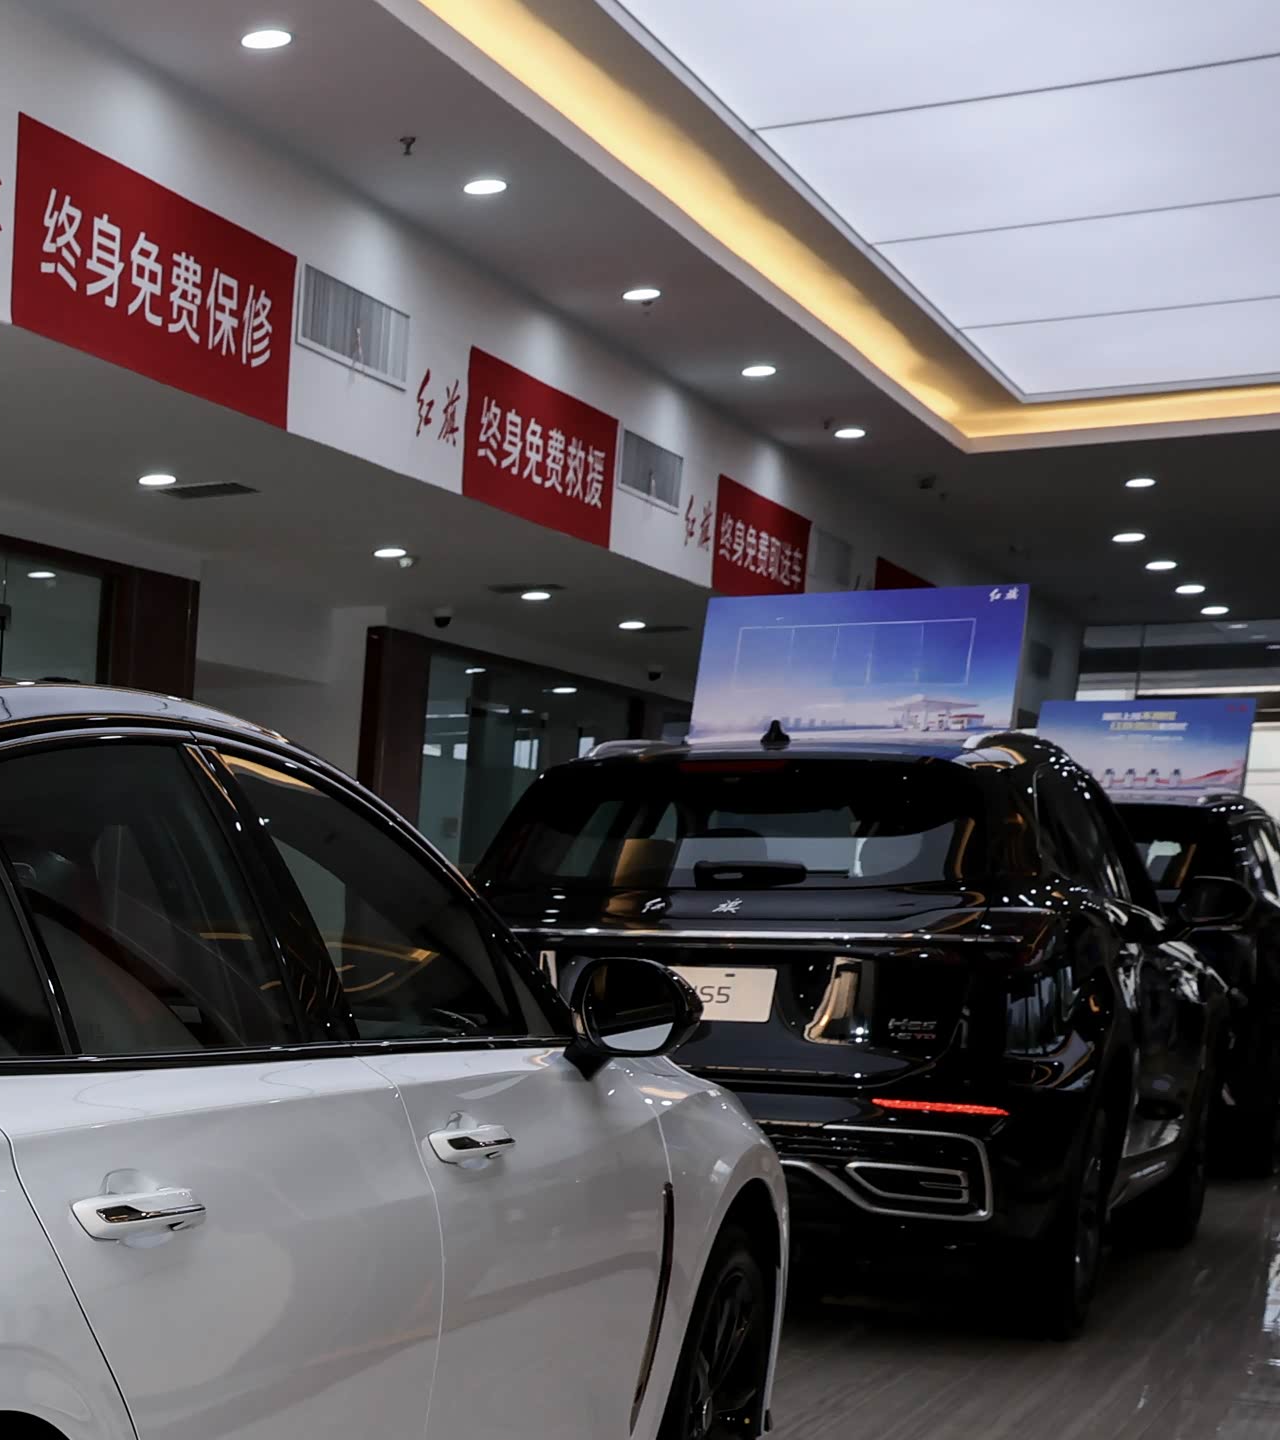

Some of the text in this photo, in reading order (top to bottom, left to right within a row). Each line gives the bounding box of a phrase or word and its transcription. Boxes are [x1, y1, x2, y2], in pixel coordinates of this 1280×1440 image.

[40, 187, 273, 368] 终身免费保修
[416, 368, 462, 448] 红旗
[477, 396, 607, 509] 终身免费救援
[684, 495, 714, 553] 红旗
[718, 512, 804, 589] 终身免费取送车
[693, 985, 732, 1004] S5
